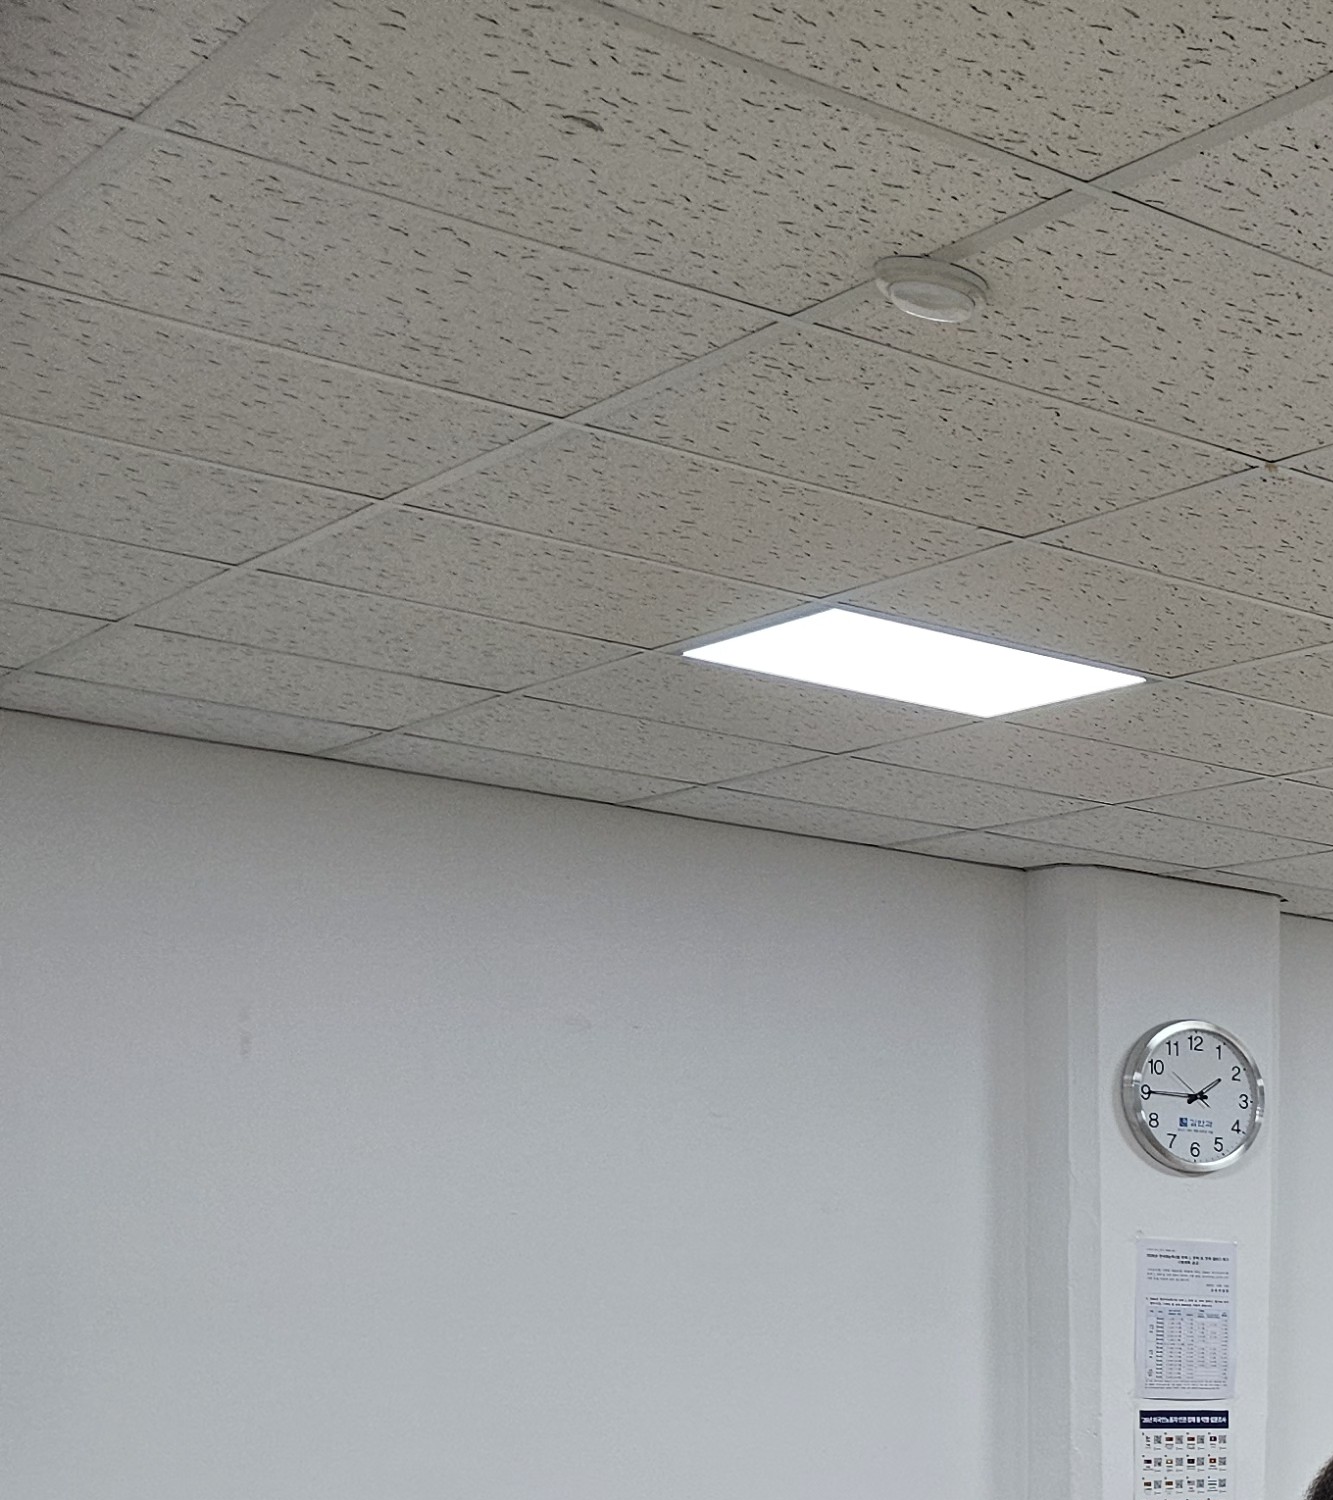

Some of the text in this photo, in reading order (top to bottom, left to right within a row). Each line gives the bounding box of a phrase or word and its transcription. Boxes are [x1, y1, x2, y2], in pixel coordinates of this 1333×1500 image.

[1165, 1040, 1179, 1056] 11
[1188, 1035, 1204, 1052] 12
[1216, 1044, 1222, 1060] 1
[1148, 1058, 1164, 1075] 10
[1231, 1066, 1241, 1081] 2
[1141, 1084, 1151, 1100] 9
[1239, 1093, 1249, 1109] 3
[1149, 1112, 1159, 1128] 8
[1231, 1119, 1241, 1134] 4
[1167, 1132, 1177, 1148] 7
[1214, 1137, 1223, 1152] 5
[1190, 1141, 1200, 1157] 6
